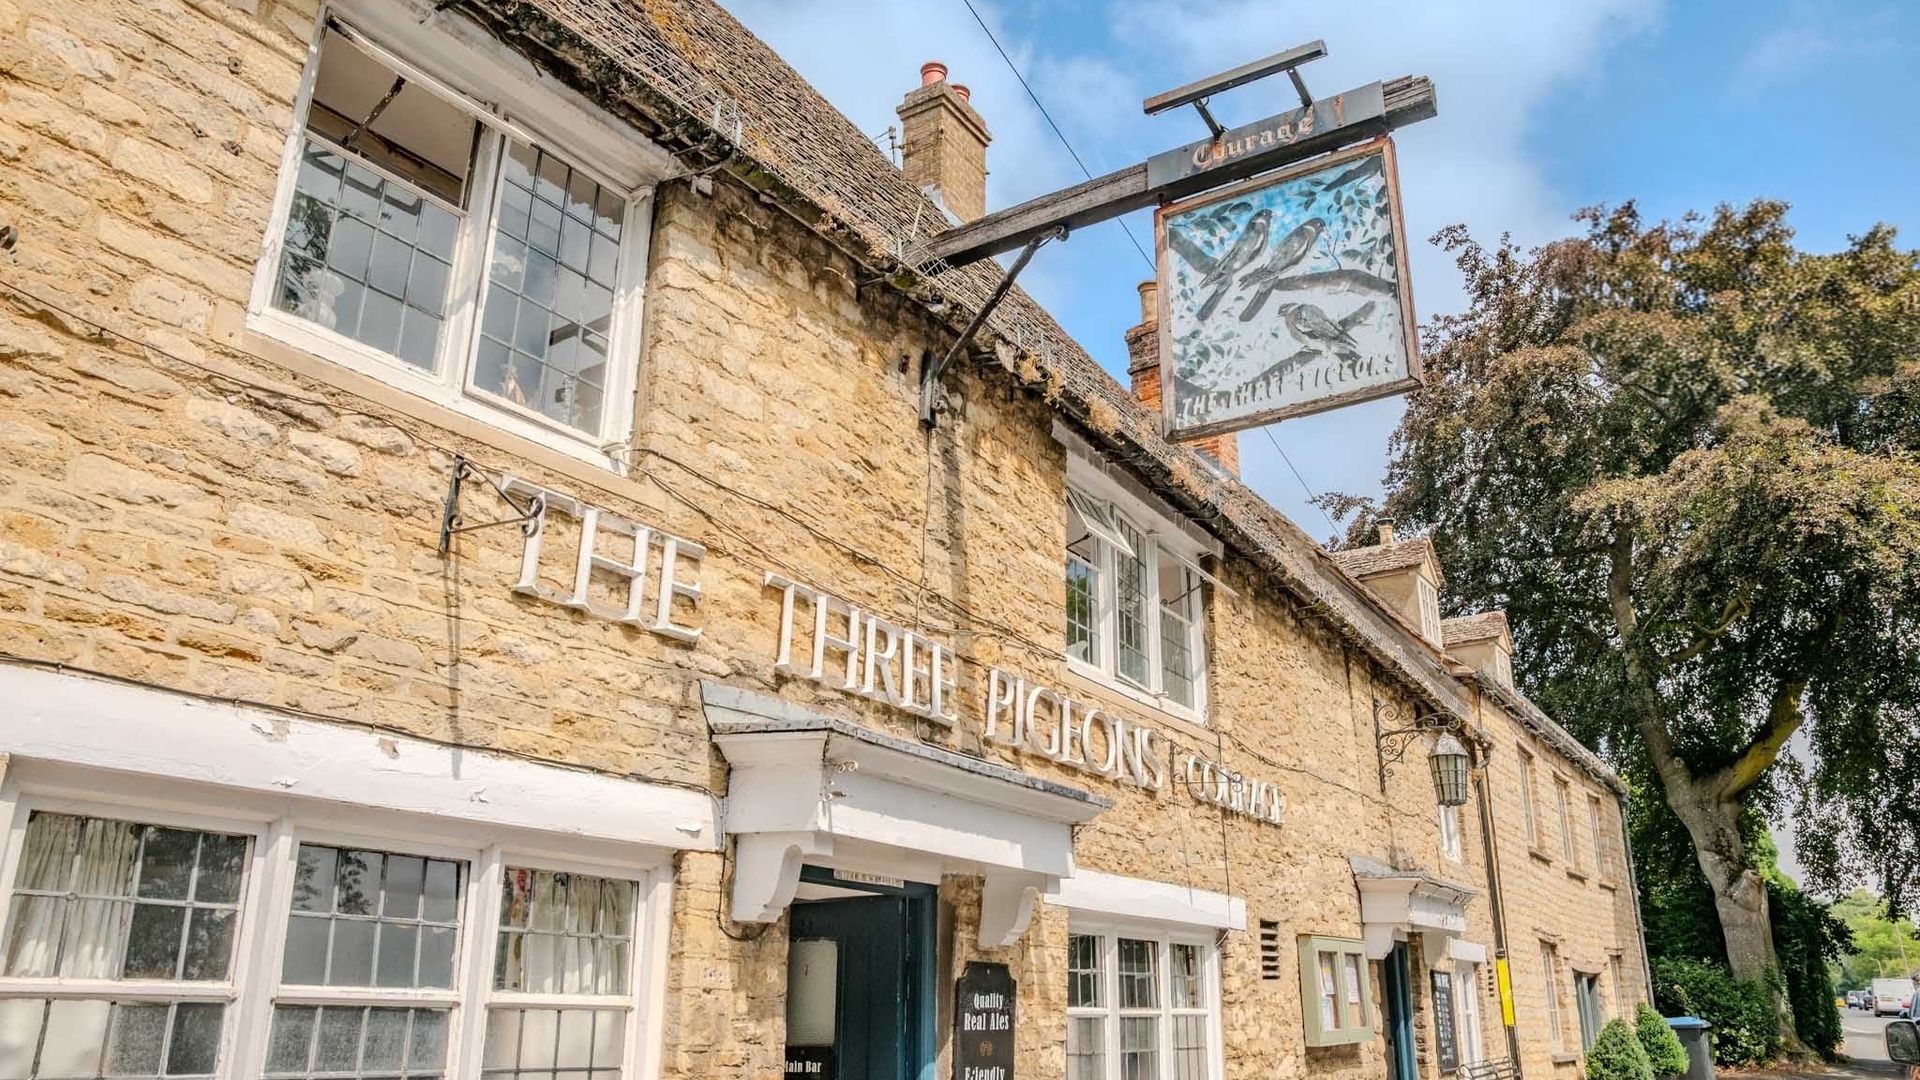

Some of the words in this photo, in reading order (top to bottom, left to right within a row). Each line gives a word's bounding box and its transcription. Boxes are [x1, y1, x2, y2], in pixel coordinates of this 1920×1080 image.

[1192, 105, 1315, 169] Courage
[501, 474, 707, 644] THE
[764, 571, 958, 728] THREE
[984, 668, 1164, 792] PIGEONS
[973, 992, 1004, 1011] Quality
[964, 1012, 986, 1031] Real
[990, 1012, 1009, 1031] Ales
[805, 1060, 822, 1073] Bar
